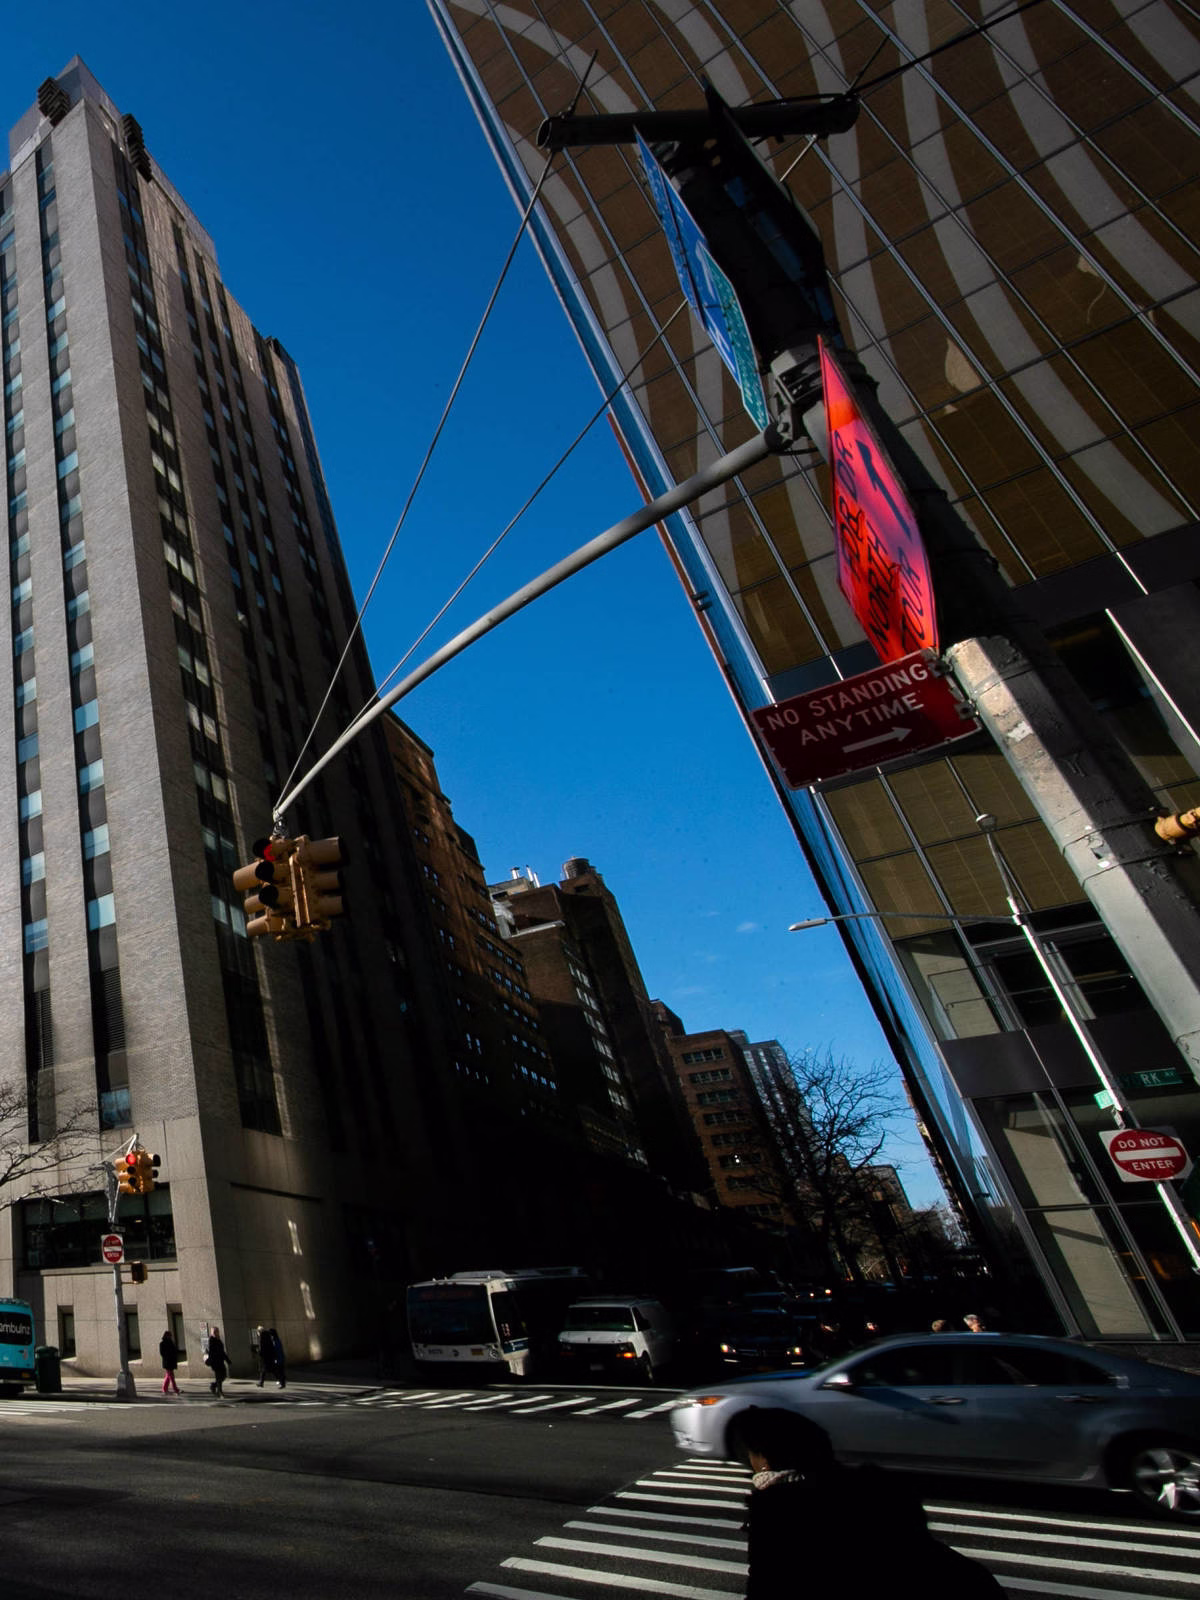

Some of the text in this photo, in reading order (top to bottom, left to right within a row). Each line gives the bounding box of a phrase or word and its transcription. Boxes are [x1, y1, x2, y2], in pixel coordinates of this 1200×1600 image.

[866, 519, 889, 657] NORTH
[766, 663, 929, 731] NO STANDING
[801, 691, 925, 746] ANYTIME
[1118, 1136, 1166, 1149] DO NOT
[1131, 1159, 1176, 1171] ENTER
